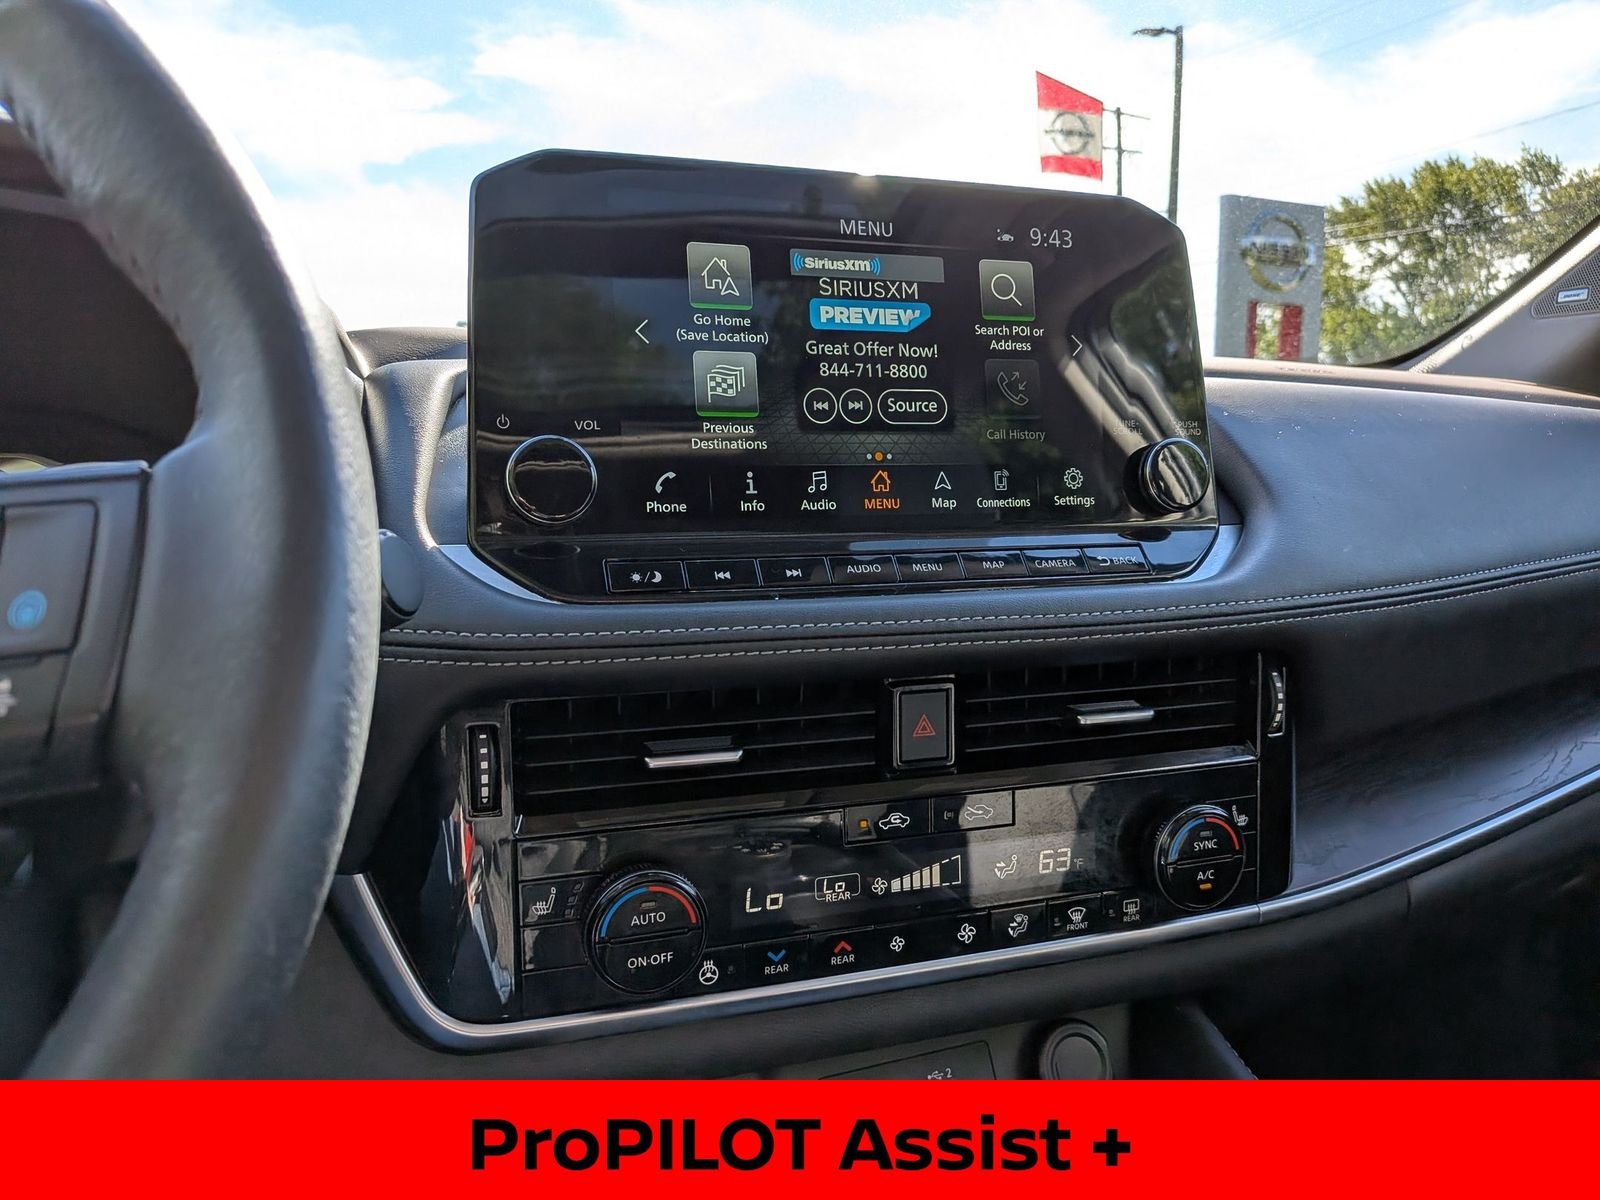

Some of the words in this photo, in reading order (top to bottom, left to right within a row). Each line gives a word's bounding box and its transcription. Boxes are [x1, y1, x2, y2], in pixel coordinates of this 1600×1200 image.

[840, 219, 893, 237] MENU
[1030, 227, 1073, 248] 9:43
[819, 277, 919, 300] SIRIUSXM
[693, 313, 711, 325] Go
[715, 315, 751, 327] Home
[820, 306, 921, 326] PREVIEW
[676, 328, 709, 342] (Save
[712, 330, 769, 345] Location)
[975, 325, 1010, 336] Search
[1012, 326, 1030, 336] POI
[1033, 328, 1044, 336] or
[806, 340, 849, 356] Great
[854, 341, 894, 357] Offer
[899, 343, 938, 358] Now!
[990, 339, 1032, 351] Address
[819, 362, 928, 379] 844-711-8800
[887, 398, 938, 413] Source
[574, 420, 601, 431] VOL
[703, 422, 754, 434] Previous
[1178, 420, 1198, 428] PUSH
[987, 429, 1007, 440] Call
[1009, 429, 1046, 442] History
[1175, 428, 1201, 436] SOUND
[691, 438, 768, 450] Destinations
[646, 501, 687, 513] Phone
[740, 500, 766, 512] Info
[800, 499, 837, 511] Audio
[864, 498, 901, 510] MENU
[932, 498, 957, 510] Map
[976, 497, 1031, 508] Connections
[1054, 495, 1096, 508] Settings
[983, 560, 1006, 570] MAP
[1035, 558, 1076, 569] CAMERA
[1112, 556, 1138, 565] BACK
[846, 563, 882, 574] AUDIO
[912, 562, 943, 573] MENU
[1193, 838, 1218, 851] SYNC
[1038, 848, 1071, 874] 63
[1197, 869, 1215, 881] A/C
[823, 879, 846, 894] Lo
[745, 888, 784, 913] Lo
[825, 891, 851, 903] REAR
[630, 912, 666, 927] AUTO
[1123, 914, 1140, 923] REAR
[1066, 921, 1089, 931] FRONT
[831, 954, 855, 966] REAR
[764, 963, 790, 976] REAR
[945, 1067, 953, 1079] 2
